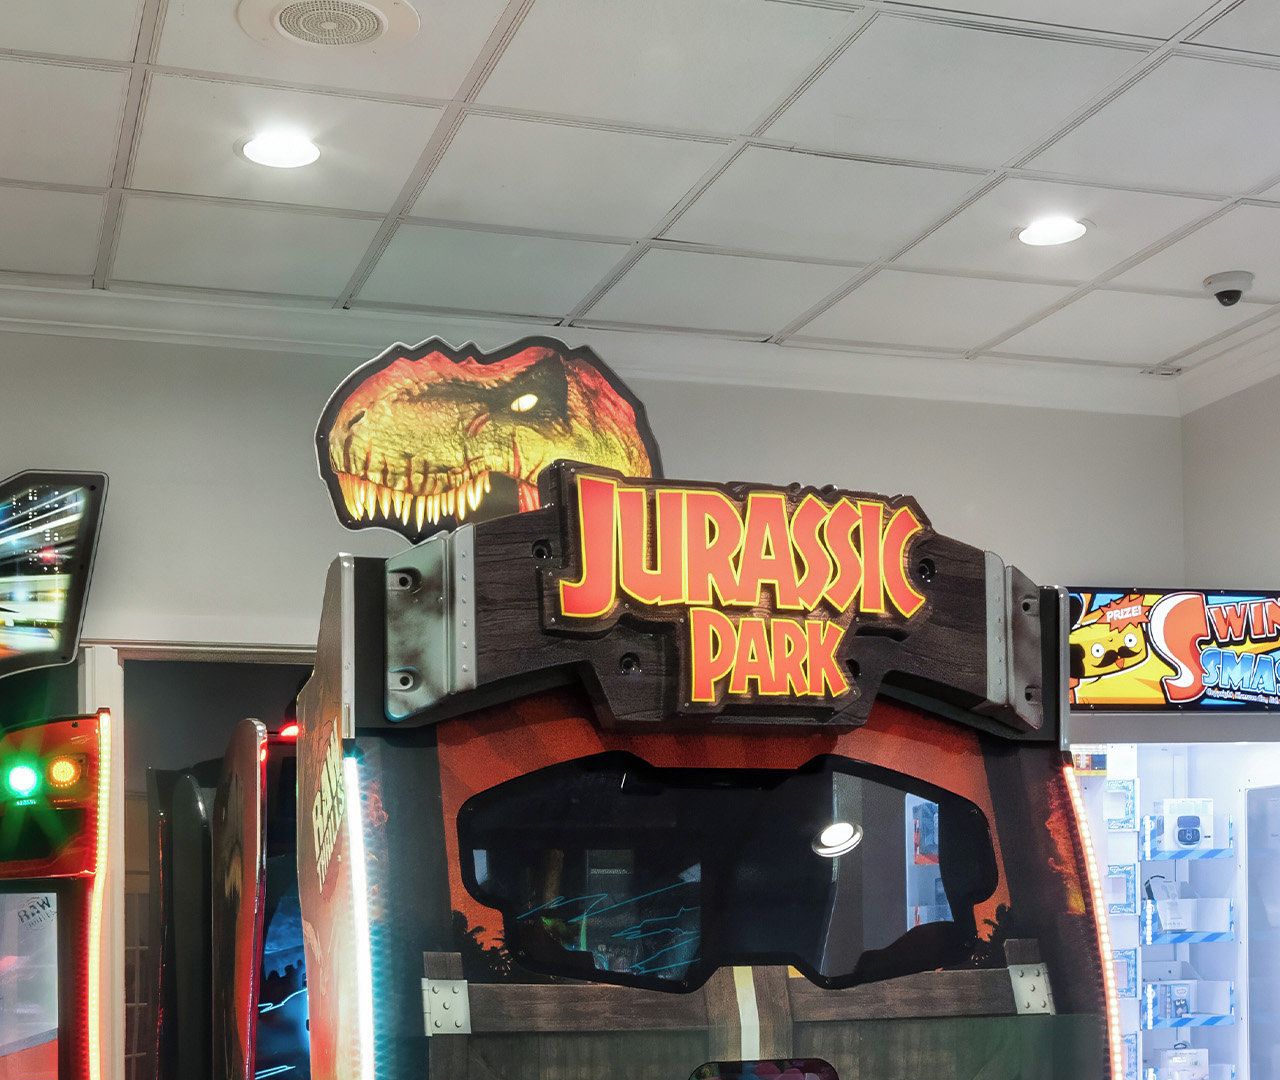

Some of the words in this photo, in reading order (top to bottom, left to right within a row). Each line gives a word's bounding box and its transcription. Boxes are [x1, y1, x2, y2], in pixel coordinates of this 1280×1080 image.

[559, 474, 926, 619] JURASSIC
[690, 607, 852, 702] PARK
[1105, 605, 1142, 622] PRIZE!
